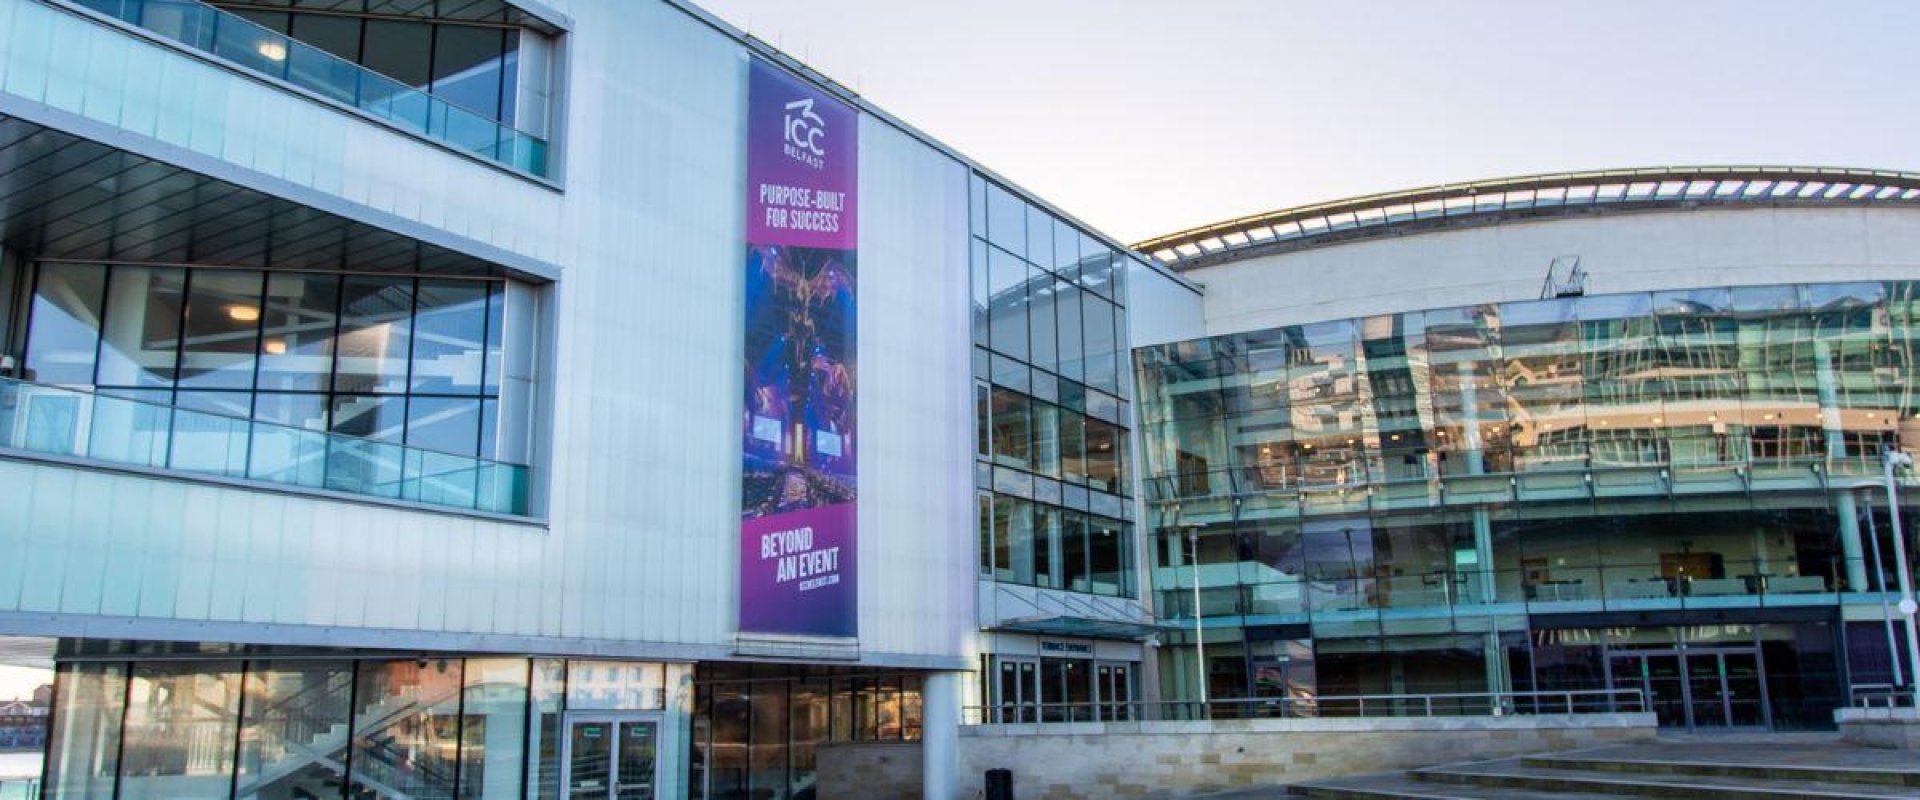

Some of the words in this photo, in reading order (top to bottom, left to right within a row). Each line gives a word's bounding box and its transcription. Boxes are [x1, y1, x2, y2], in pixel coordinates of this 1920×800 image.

[784, 114, 824, 156] ICC
[784, 144, 824, 169] BELFAST
[760, 184, 845, 211] PURPOSE-BUILT
[766, 208, 788, 228] FOR
[790, 211, 839, 232] SUCCESS
[761, 527, 812, 559] BEYOND
[777, 557, 797, 582] AN
[799, 547, 839, 577] EVENT
